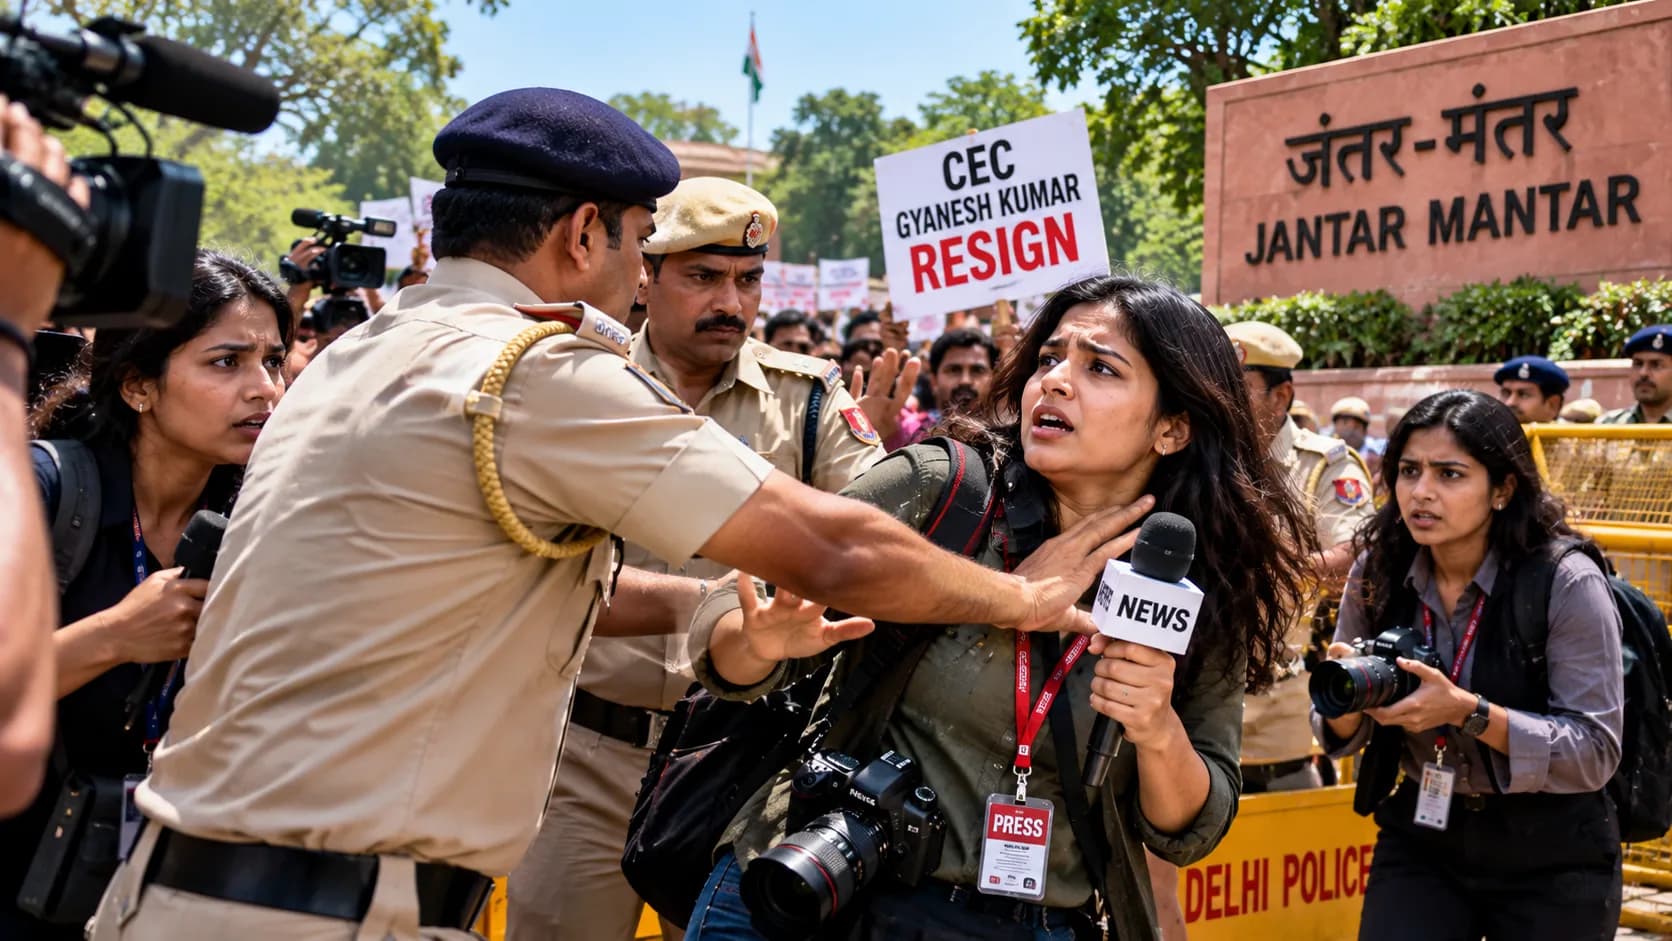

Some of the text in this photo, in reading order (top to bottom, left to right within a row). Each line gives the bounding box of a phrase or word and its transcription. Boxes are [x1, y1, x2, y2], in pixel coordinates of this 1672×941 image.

[942, 139, 1015, 191] CEC
[1285, 83, 1579, 187] जंतर-मंतर
[896, 173, 1081, 239] GYANESH KUMAR
[1245, 174, 1641, 266] JANTAR MANTAR
[910, 212, 1079, 293] RESIGN
[1116, 594, 1190, 632] NEWS
[993, 814, 1043, 837] PRESS
[1185, 844, 1373, 924] DELHI POLICE
